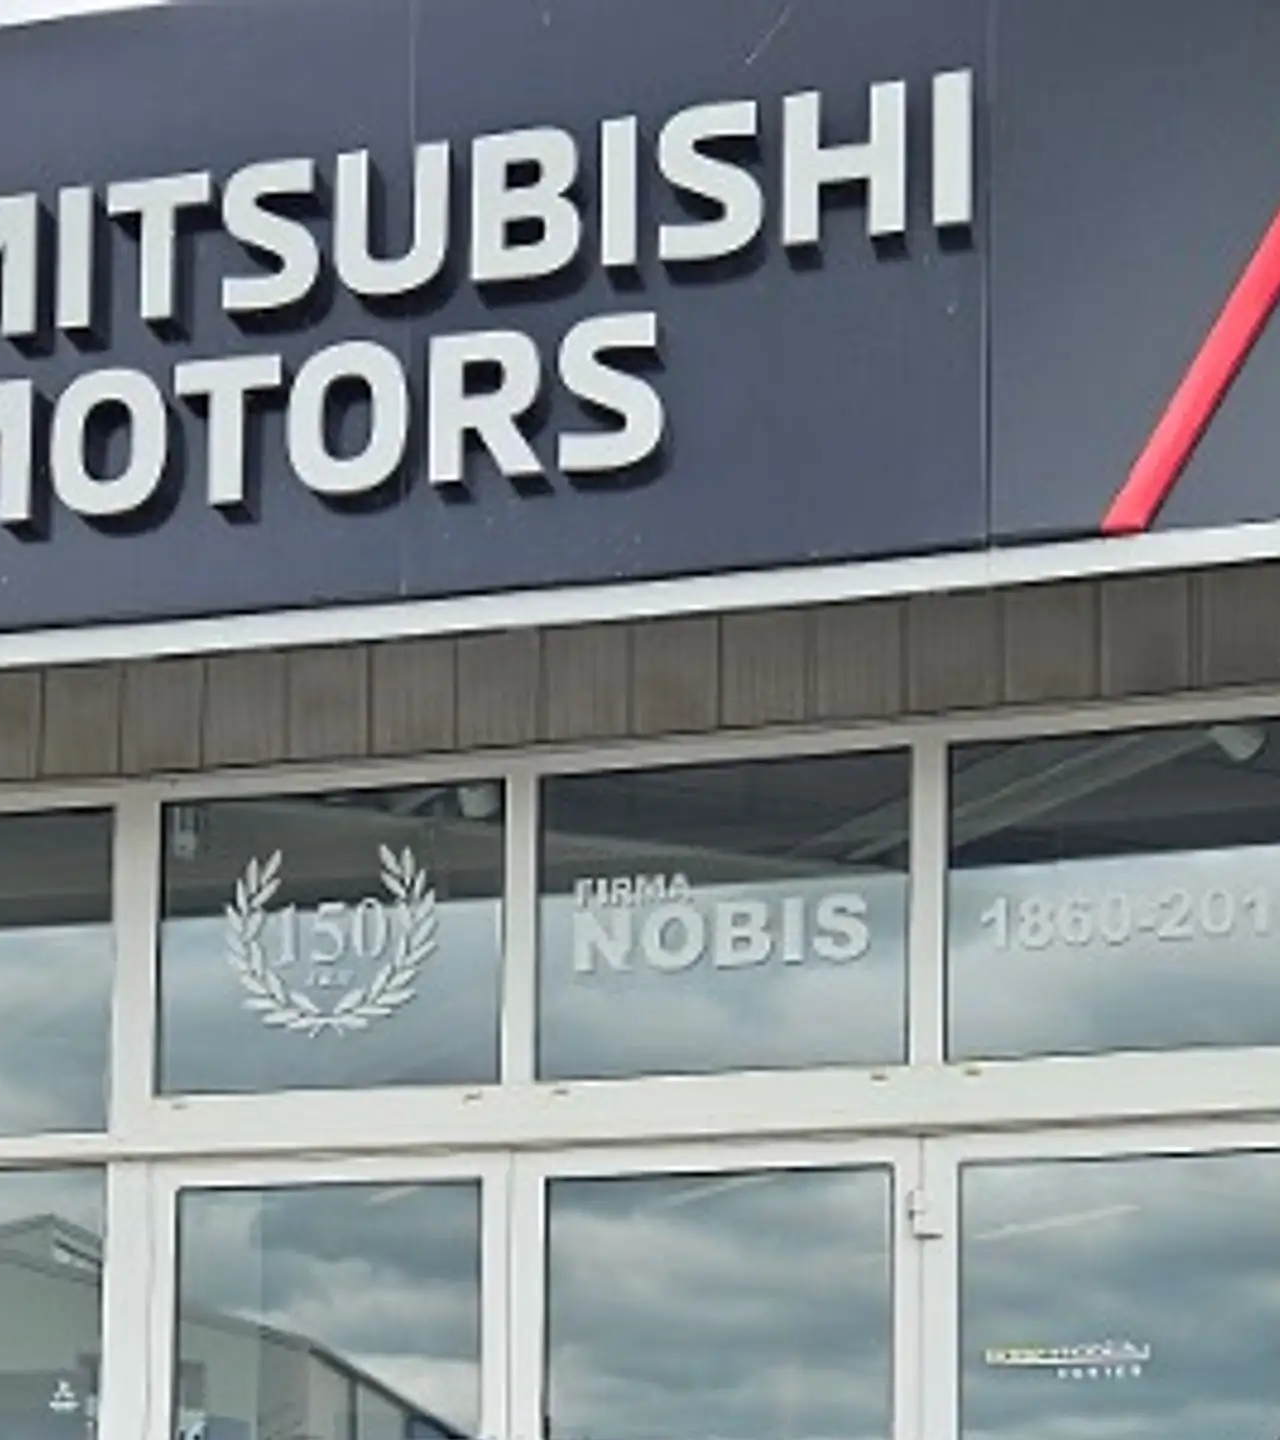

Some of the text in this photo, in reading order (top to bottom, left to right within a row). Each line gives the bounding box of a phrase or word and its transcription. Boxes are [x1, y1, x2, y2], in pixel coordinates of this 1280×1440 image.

[575, 872, 690, 906] FIRMA
[272, 897, 386, 963] 150
[572, 892, 870, 972] NOBIS
